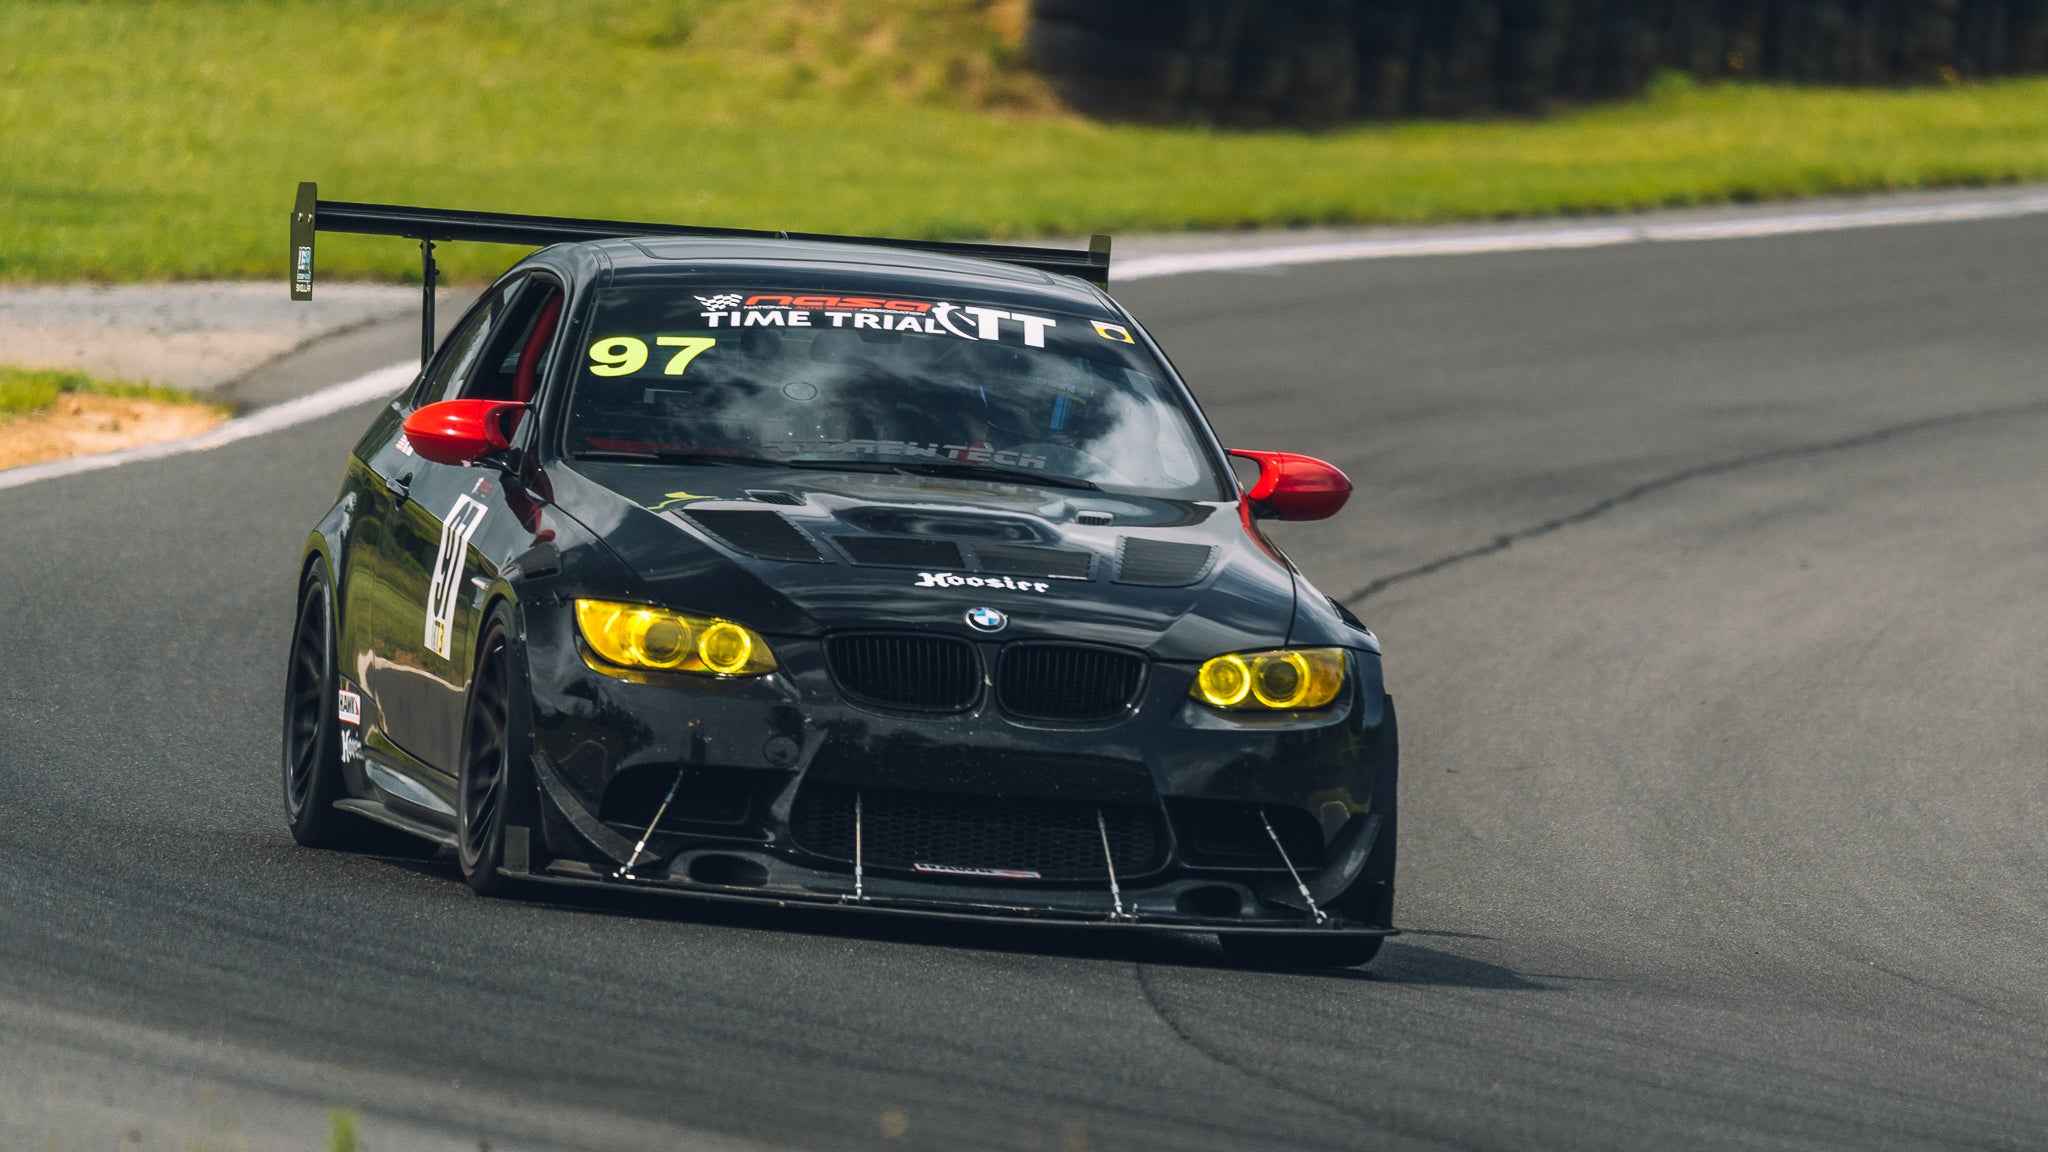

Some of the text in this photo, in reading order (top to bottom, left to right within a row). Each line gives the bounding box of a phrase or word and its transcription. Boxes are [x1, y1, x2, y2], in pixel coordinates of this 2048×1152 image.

[700, 310, 947, 335] TIME TRIAL
[964, 306, 1057, 348] TT
[589, 336, 716, 377] 97
[914, 572, 1050, 593] Hoosier
